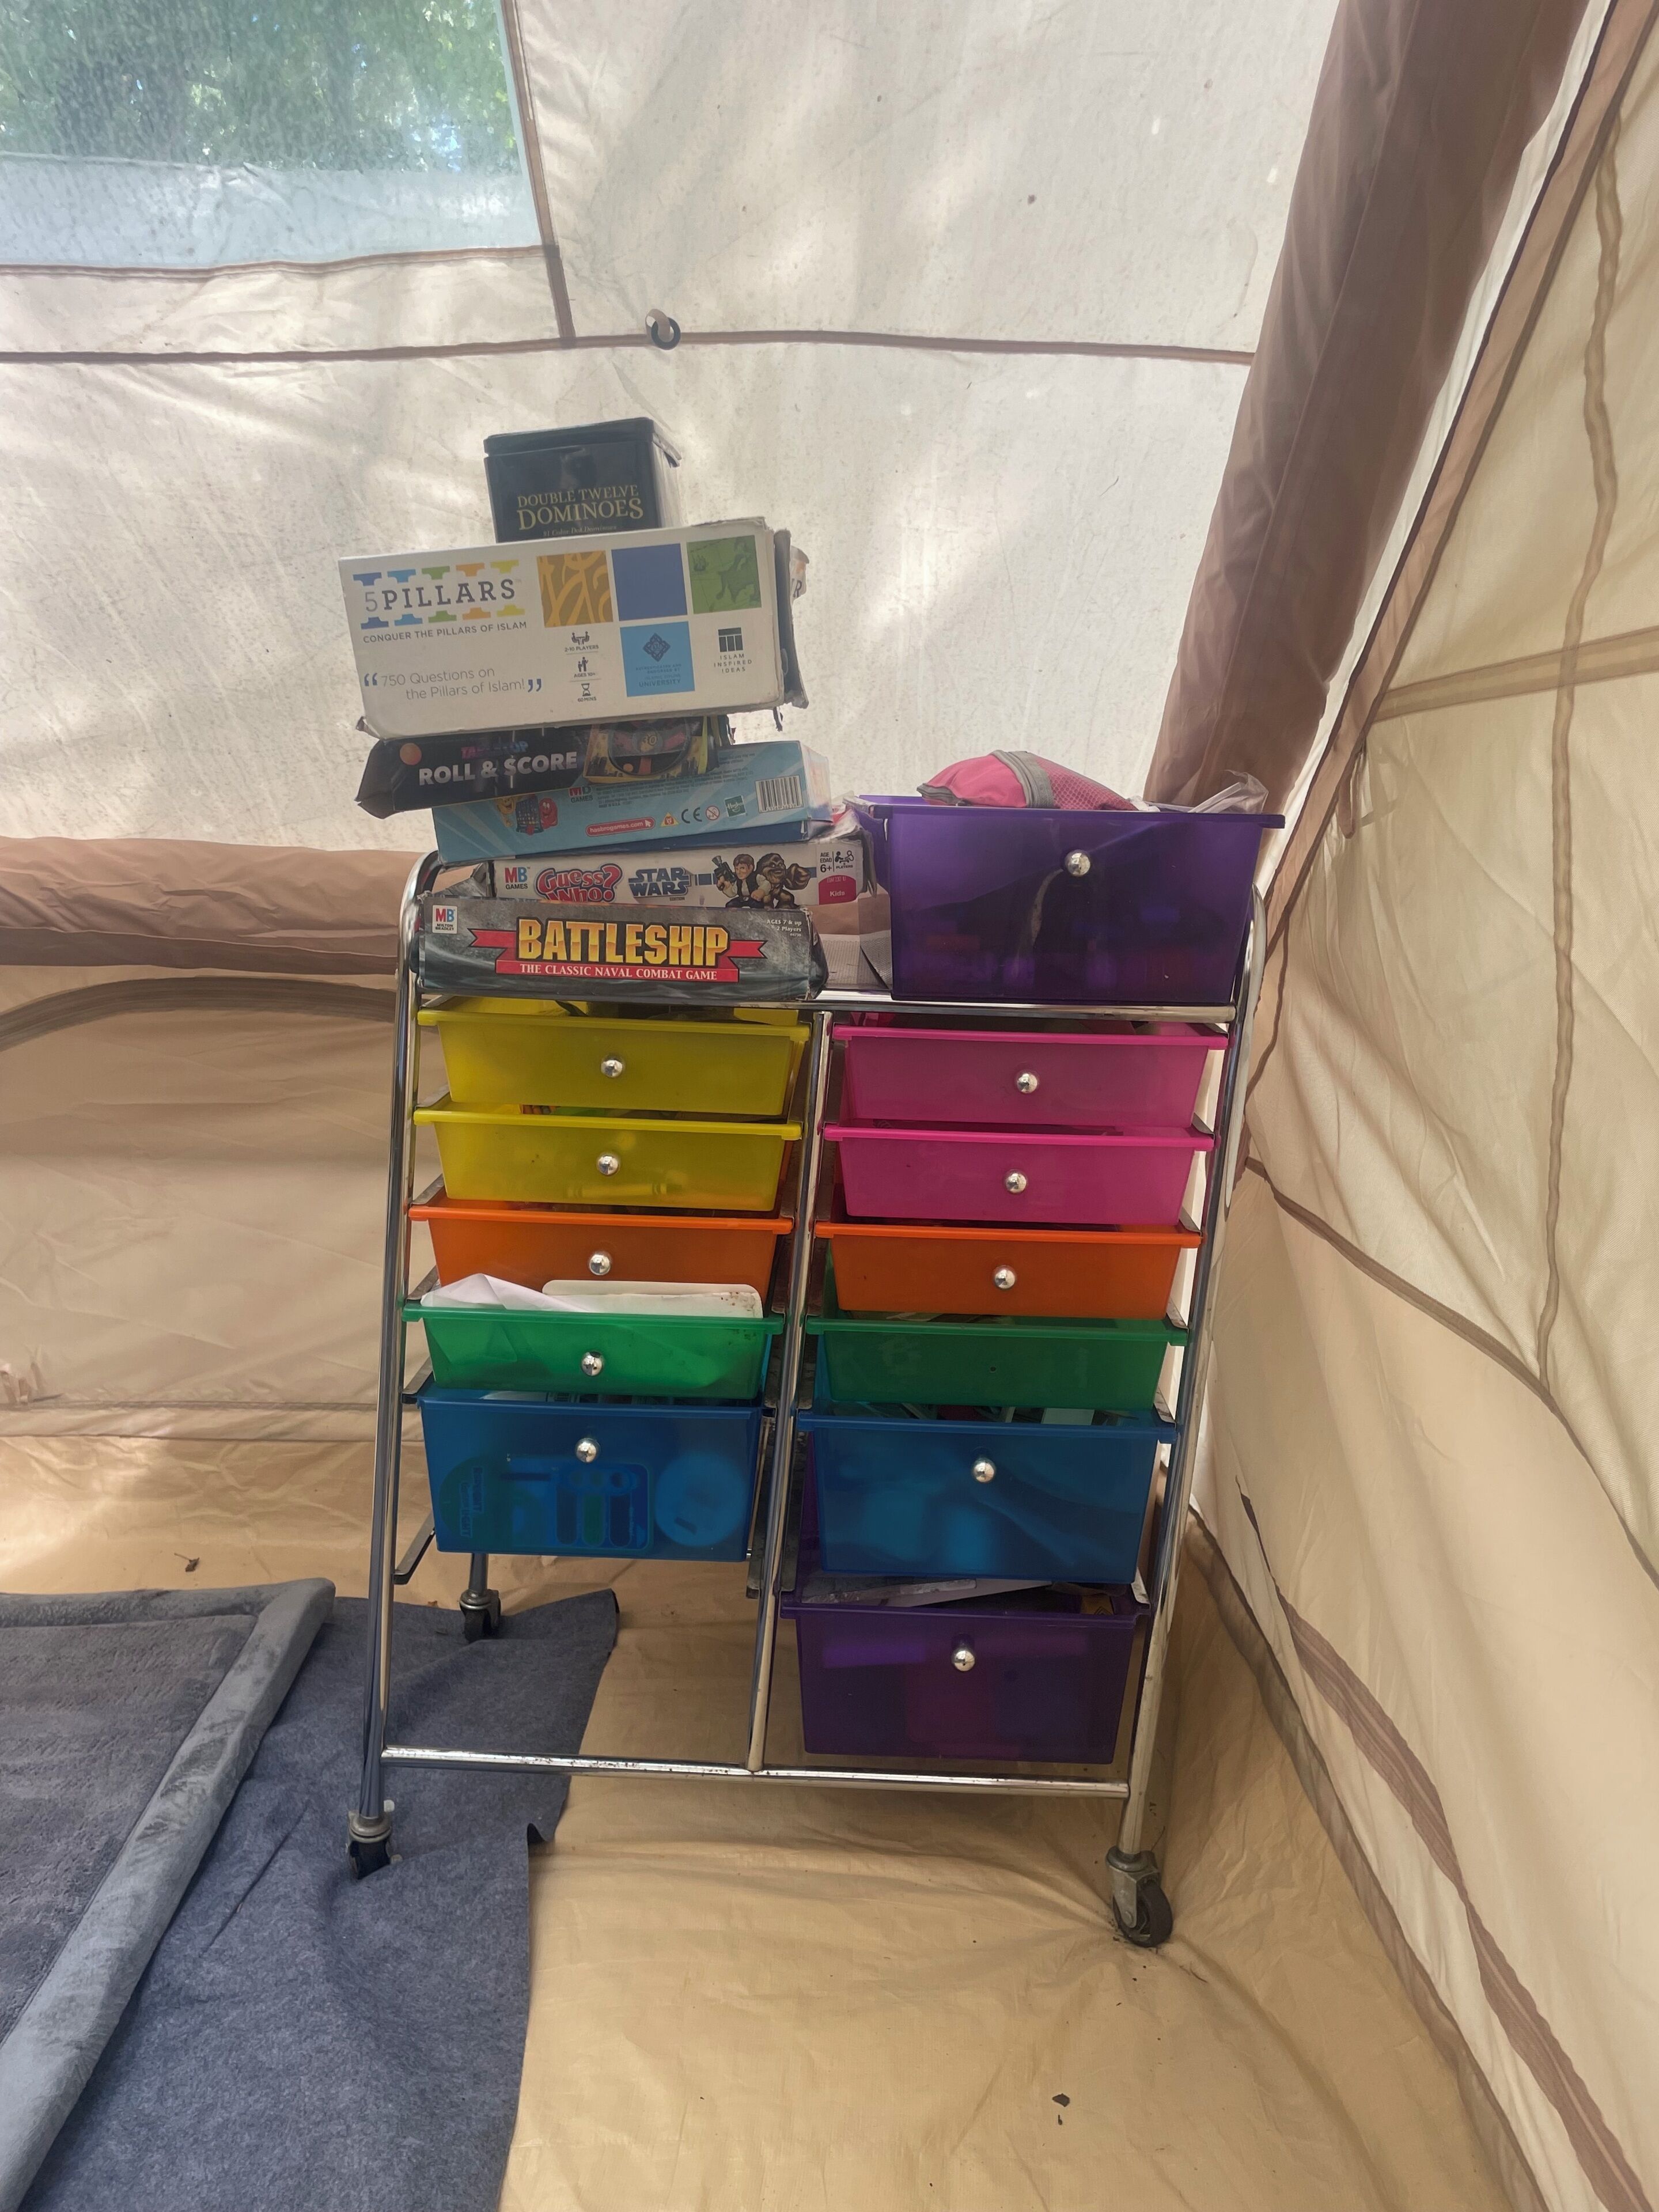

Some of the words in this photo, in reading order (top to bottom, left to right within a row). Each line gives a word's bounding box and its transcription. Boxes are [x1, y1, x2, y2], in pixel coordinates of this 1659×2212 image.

[517, 490, 576, 508] DOUBLE
[578, 484, 639, 501] TWELVE
[517, 498, 643, 531] DOMINOES
[363, 632, 411, 643] CONQUER
[415, 630, 434, 639] THE
[437, 626, 477, 637] PILLARS
[480, 624, 494, 632] OF
[497, 622, 527, 631] ISLAM
[714, 659, 752, 668] INSPIRED
[410, 670, 475, 685] Questions
[478, 668, 495, 678] on
[638, 679, 681, 687] UNIVERSITY
[406, 690, 427, 700] the
[430, 684, 468, 698] Pillars
[471, 682, 484, 695] of
[419, 763, 476, 786] ROLL
[480, 760, 498, 778] &
[503, 752, 577, 777] SCORE
[590, 820, 644, 833] hasbrogames.com
[505, 866, 528, 884] MB
[628, 867, 690, 882] STAR
[820, 863, 832, 873] 6+
[628, 881, 690, 897] WARS
[435, 908, 454, 922] MB
[518, 919, 729, 966] BATTLESHIP
[520, 963, 541, 974] THE
[544, 964, 592, 976] CLASSIC
[595, 967, 632, 978] NAVAL
[636, 968, 682, 979] COMBAT
[685, 969, 717, 980] GAME
